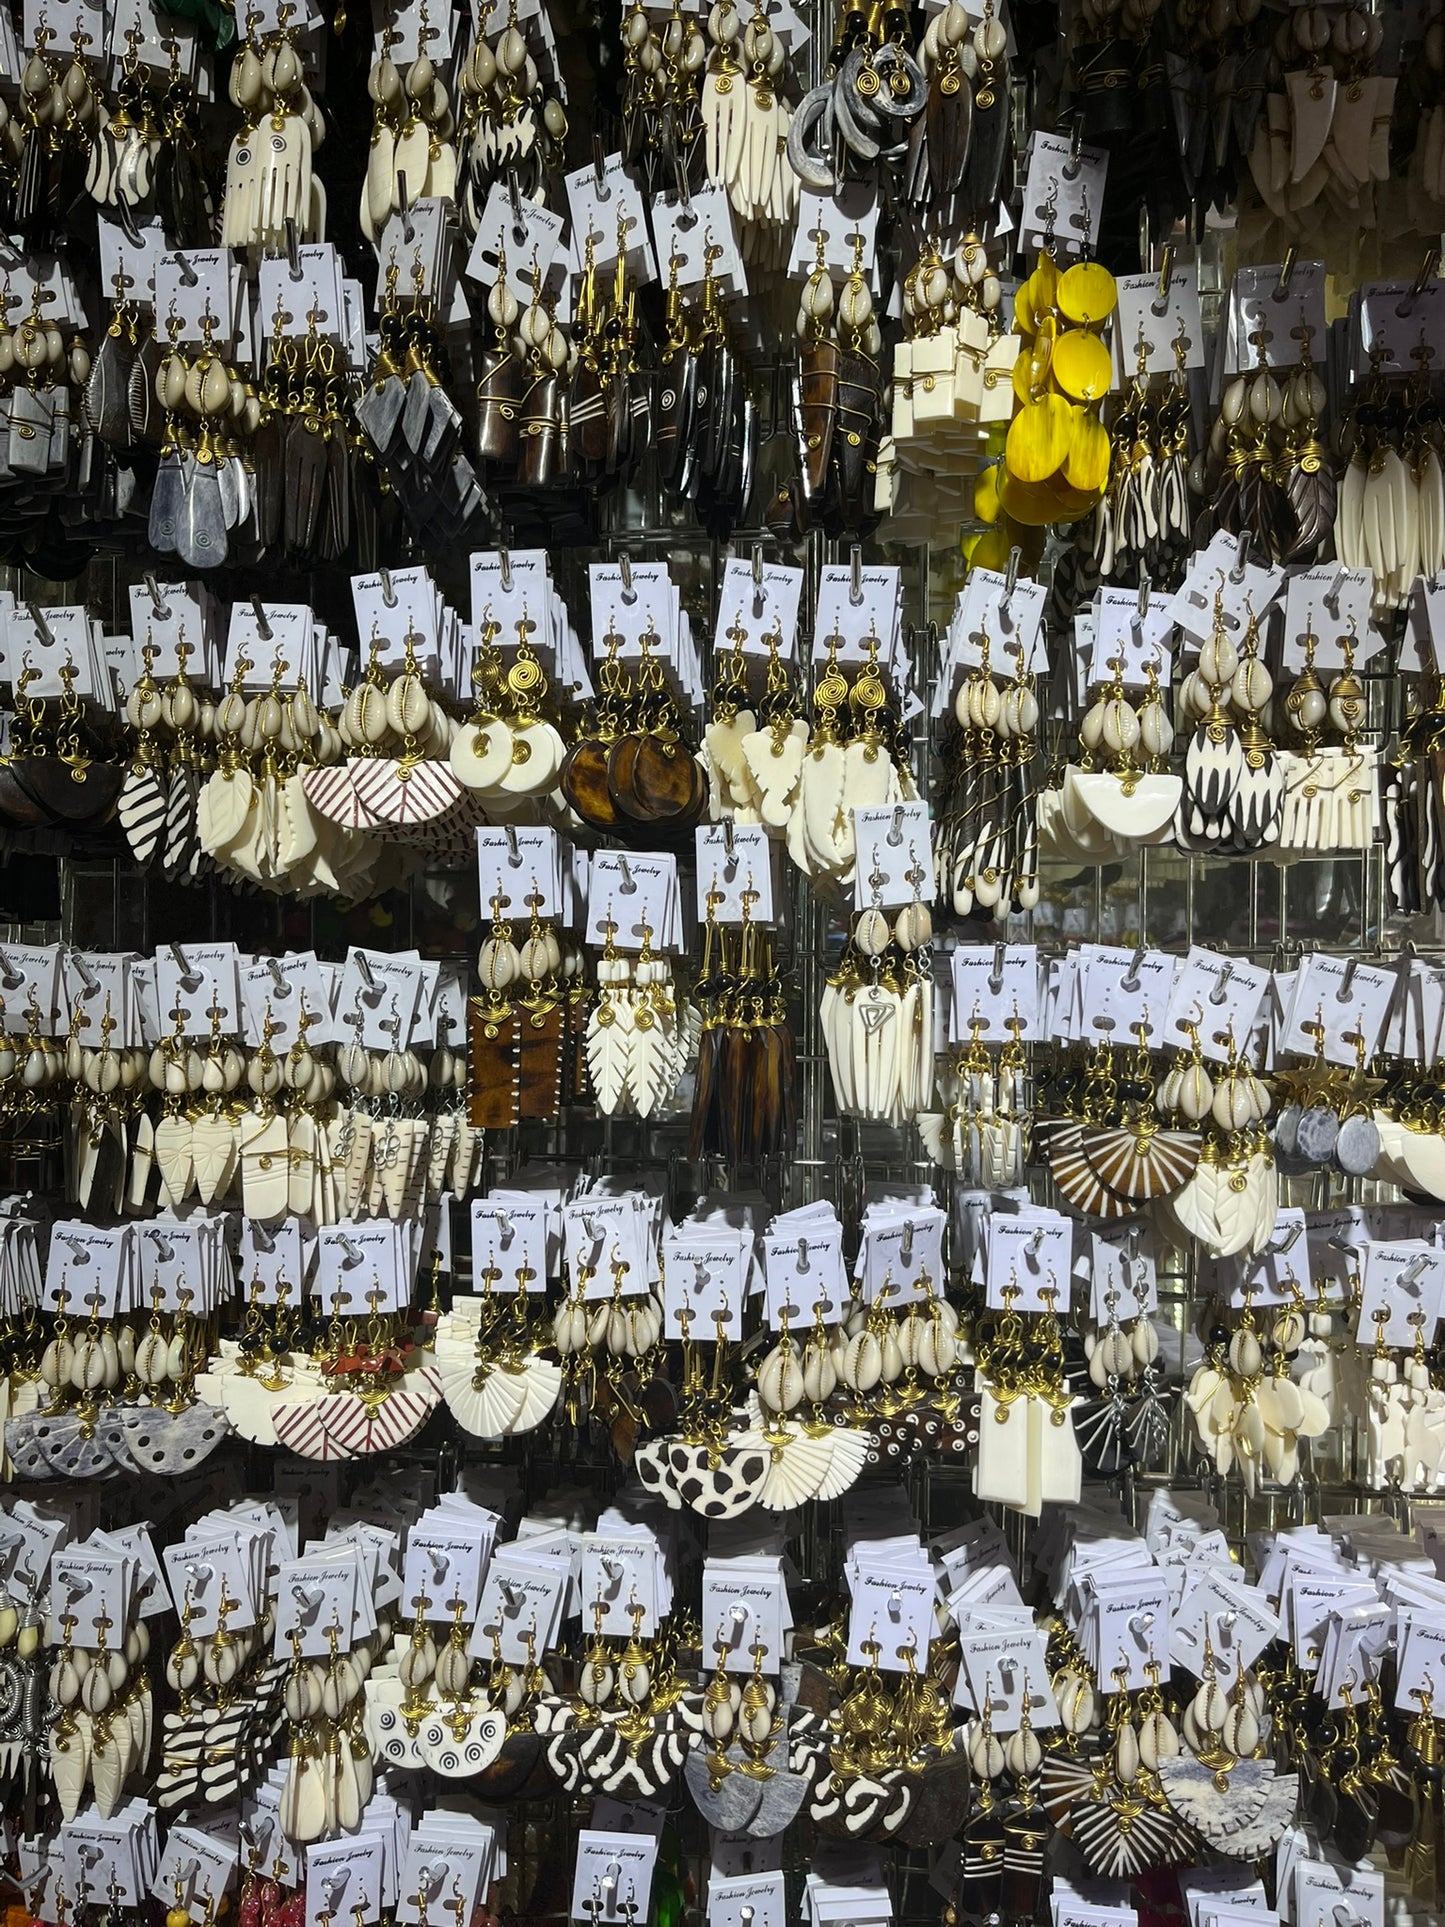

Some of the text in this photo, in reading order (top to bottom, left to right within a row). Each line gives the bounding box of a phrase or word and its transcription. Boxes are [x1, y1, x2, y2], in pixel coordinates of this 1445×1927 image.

[1040, 140, 1068, 153] Fashio
[411, 204, 434, 215] Jewelry
[527, 209, 557, 229] Jewelry
[192, 254, 220, 266] Jewelry
[1122, 279, 1155, 290] Fashion
[1220, 537, 1238, 551] Fash
[474, 562, 501, 571] Fashio
[390, 574, 418, 585] Jewelry
[630, 571, 659, 582] Jewelry
[764, 572, 793, 585] Jewelry
[860, 574, 889, 586] Jewelry
[1300, 572, 1332, 581] Fashion
[979, 572, 1038, 598] Fashio ewelry
[161, 586, 189, 597] Jewelry
[1106, 595, 1167, 612] Fashion welry
[43, 611, 75, 622] Jewelry
[267, 611, 298, 621] Jewelry
[106, 647, 125, 657] welry
[862, 812, 891, 822] Fashion
[482, 837, 543, 847] Fashio Jewelry
[732, 835, 761, 846] Jewelry
[632, 865, 661, 877] Jewelry
[19, 954, 49, 967] Jewelry
[194, 951, 225, 962] Jewelry
[961, 957, 1027, 968] Fashion welry
[94, 961, 116, 973] Jewelry
[1096, 955, 1163, 972] Fashion welry
[1193, 960, 1220, 974] Fashio
[247, 960, 308, 981] Fashio Jewelry
[382, 963, 413, 977] Jewelry
[1315, 962, 1384, 987] Fashio Jewelry
[508, 1210, 536, 1220] Jewelry
[596, 1204, 624, 1216] Jewelry
[271, 1225, 293, 1235] Jewelry
[876, 1224, 934, 1242] Fashio ewelry
[998, 1226, 1032, 1235] Fashion
[84, 1237, 114, 1248] Jewelry
[168, 1231, 190, 1242] Jewelry
[356, 1234, 386, 1245] Jewelry
[771, 1242, 831, 1256] Fashio ewelry
[702, 1252, 735, 1264] Jewelry
[1375, 1251, 1406, 1262] Fashion
[24, 1521, 49, 1539] Jewelry
[412, 1539, 473, 1552] Fashion Jewelry
[587, 1545, 644, 1557] Fashion Jewelry
[171, 1545, 229, 1563] Fashion Jewelry
[56, 1562, 113, 1573] Fashion Jewelry
[288, 1571, 349, 1583] Fashion Jewelry
[521, 1582, 552, 1596] Jewelry
[709, 1583, 772, 1598] Fashion Jewelry
[865, 1577, 927, 1595] Fashion Jewelry
[986, 1583, 1006, 1601] Jewelry
[1300, 1587, 1336, 1597] Fashion
[1106, 1599, 1162, 1613] Fashion Jewelry
[1208, 1583, 1266, 1632] Fashion Jewelry
[1346, 1619, 1385, 1632] Fashion Jewelry
[1417, 1630, 1445, 1643] Fashio
[970, 1639, 1032, 1653] Fashion Jewelry
[67, 1832, 122, 1845] Fashion Jewelry
[173, 1833, 224, 1866] Fashion Jewelry
[414, 1844, 475, 1860] Fashion Jewelry
[617, 1848, 646, 1860] Jewelry
[312, 1848, 374, 1868] Fashion Jewelry
[714, 1885, 776, 1900] Fashion Jewelry
[1305, 1876, 1374, 1900] Fashion Jewelry
